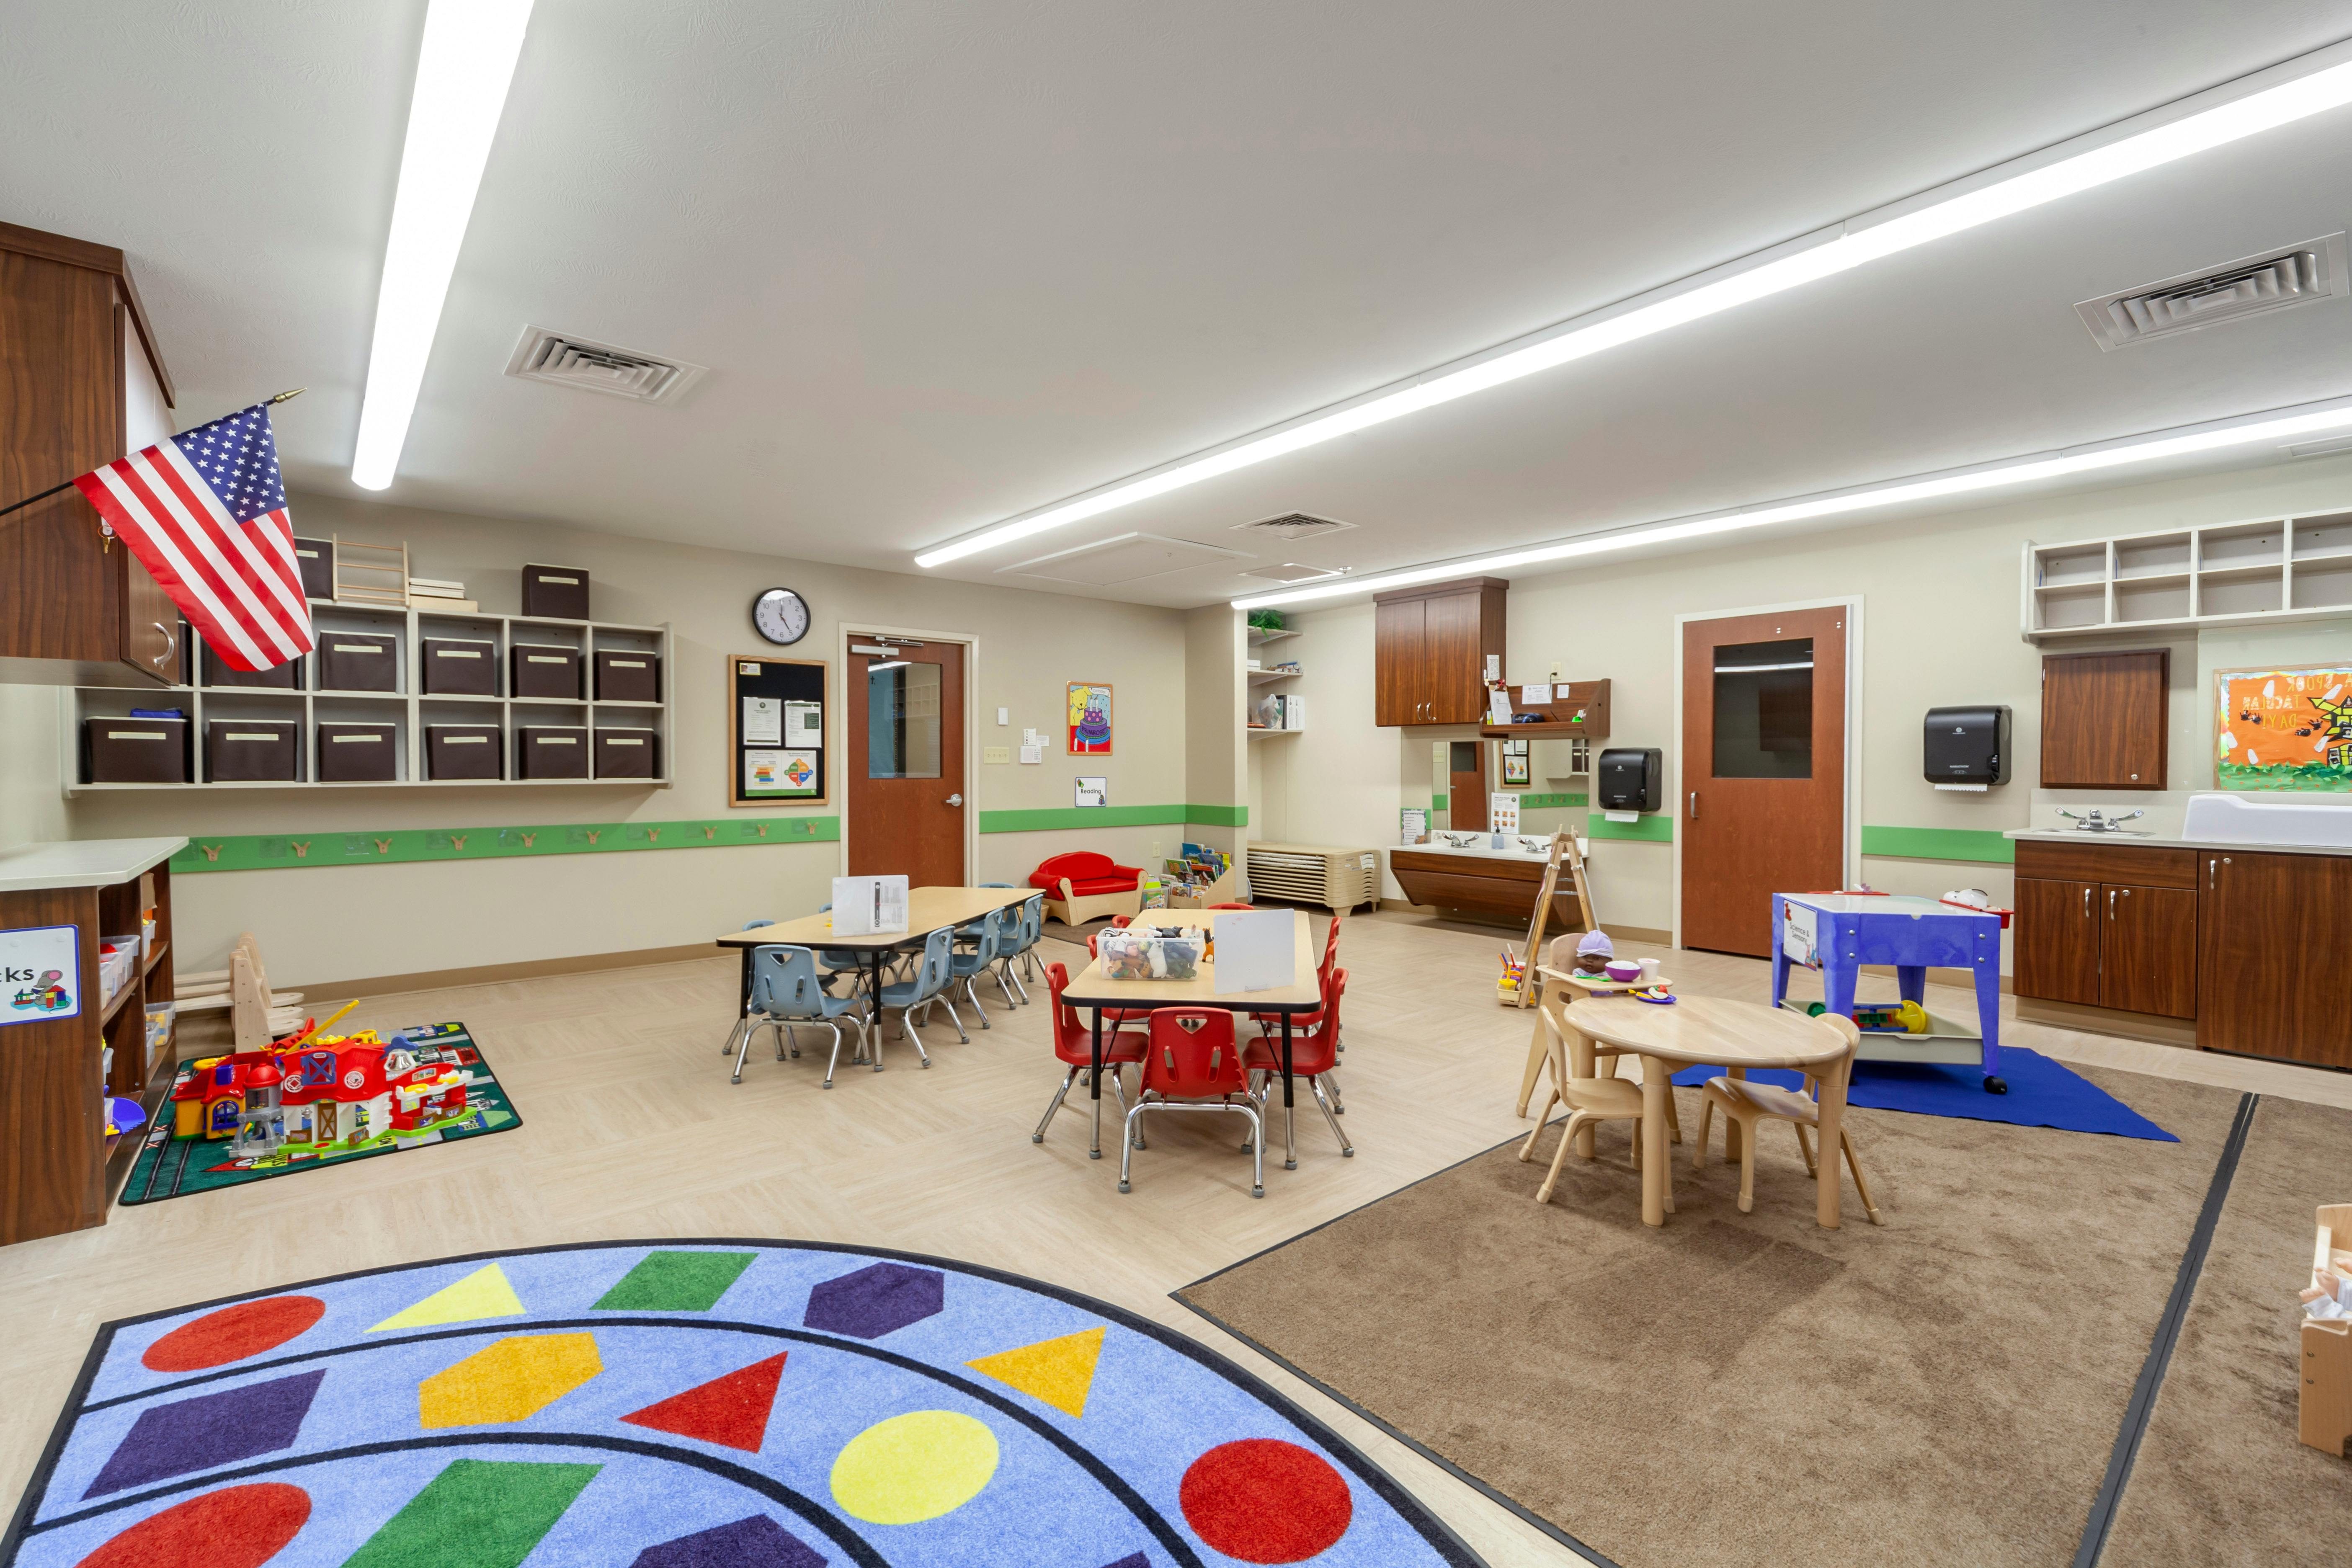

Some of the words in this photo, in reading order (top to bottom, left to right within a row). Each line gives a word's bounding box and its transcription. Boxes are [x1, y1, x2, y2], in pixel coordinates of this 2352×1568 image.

[1082, 726, 1107, 735] PRIMROSE
[1170, 863, 1185, 873] ABC
[1790, 922, 1805, 935] Science
[1792, 931, 1808, 945] Sensory
[0, 967, 34, 983] ks
